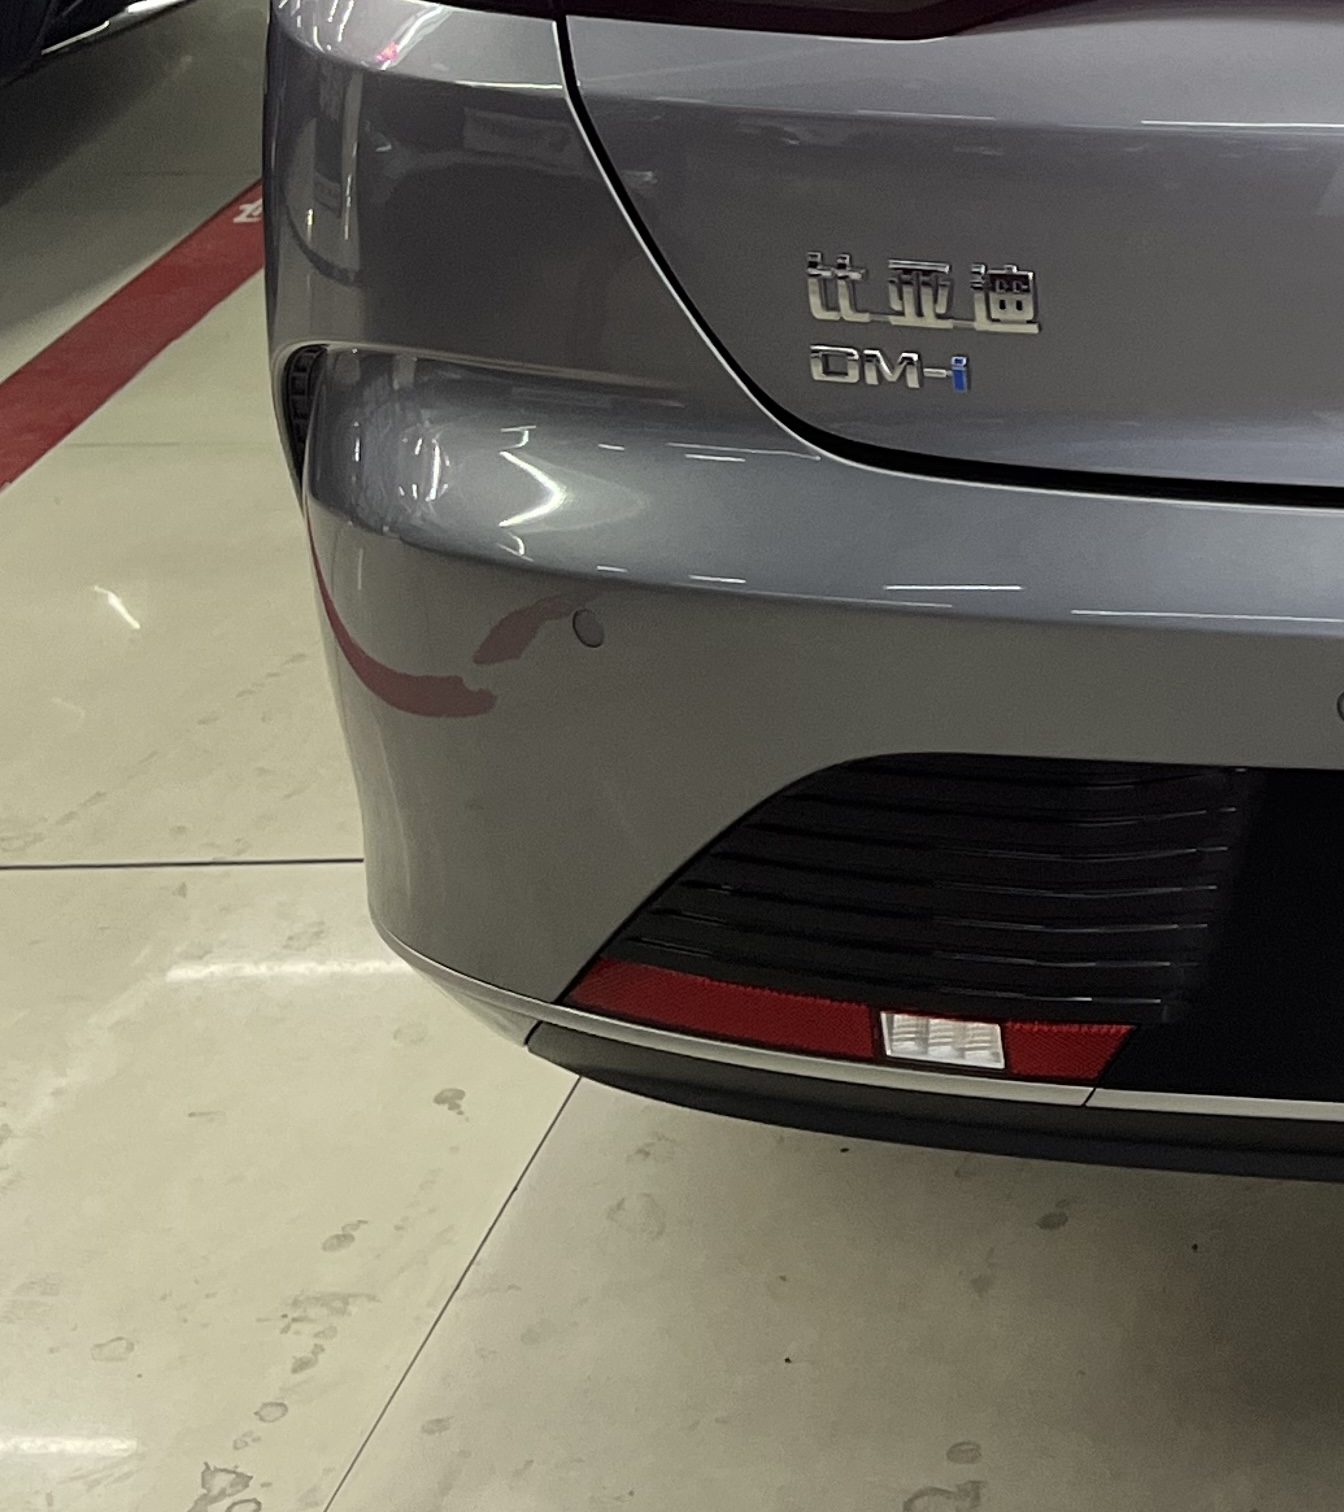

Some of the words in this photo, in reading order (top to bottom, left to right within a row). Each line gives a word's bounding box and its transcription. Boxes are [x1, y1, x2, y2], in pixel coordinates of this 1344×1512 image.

[806, 251, 1041, 334] 比亚迪
[809, 344, 969, 392] DM-i
